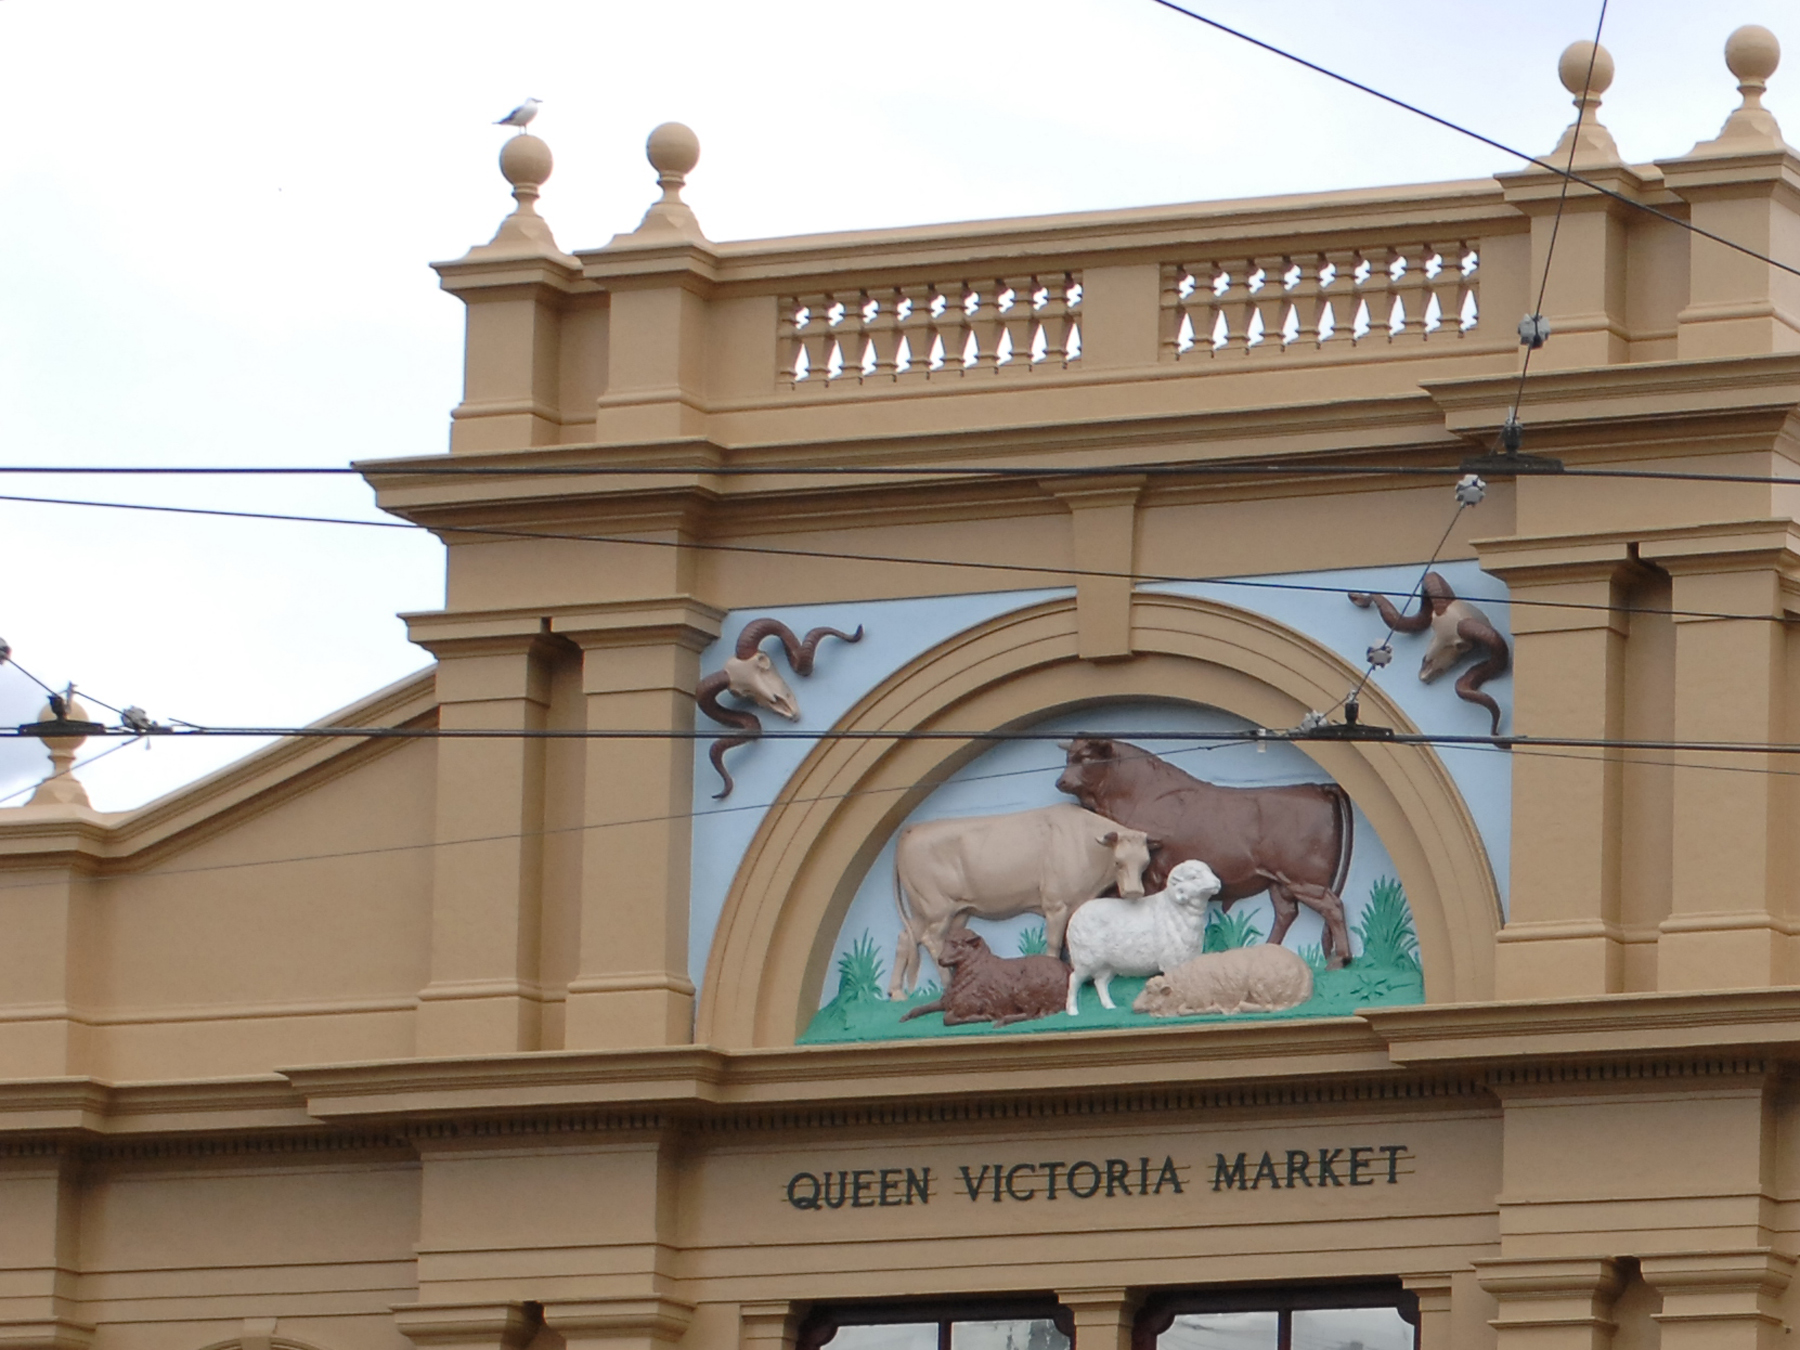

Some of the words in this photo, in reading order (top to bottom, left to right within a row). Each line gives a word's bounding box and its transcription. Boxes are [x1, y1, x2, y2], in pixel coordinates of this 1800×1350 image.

[787, 1167, 931, 1211] QUEEN
[960, 1156, 1185, 1203] VICTORIA
[1212, 1146, 1408, 1192] MARKET
